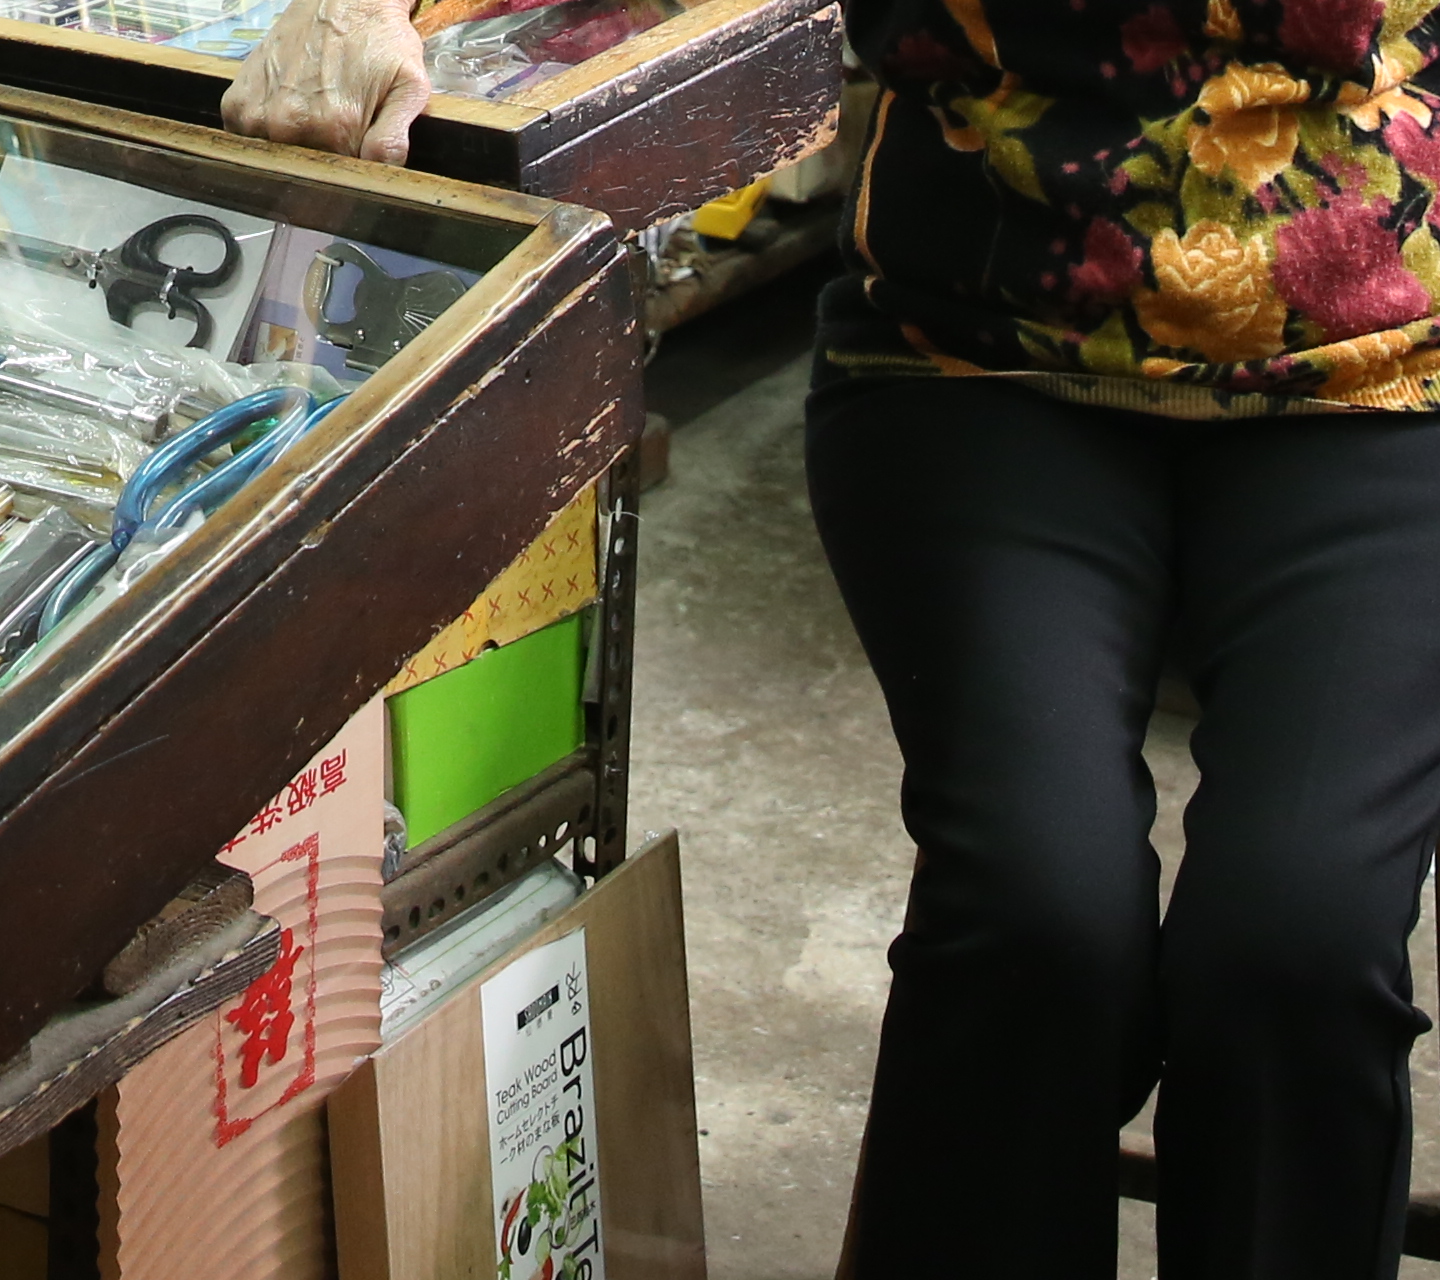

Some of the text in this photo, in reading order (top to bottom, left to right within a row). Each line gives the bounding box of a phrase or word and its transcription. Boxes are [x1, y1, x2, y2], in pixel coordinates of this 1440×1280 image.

[494, 1048, 558, 1108] Teak Wood
[496, 1068, 559, 1127] Cutting Board
[559, 1025, 596, 1211] Brazil
